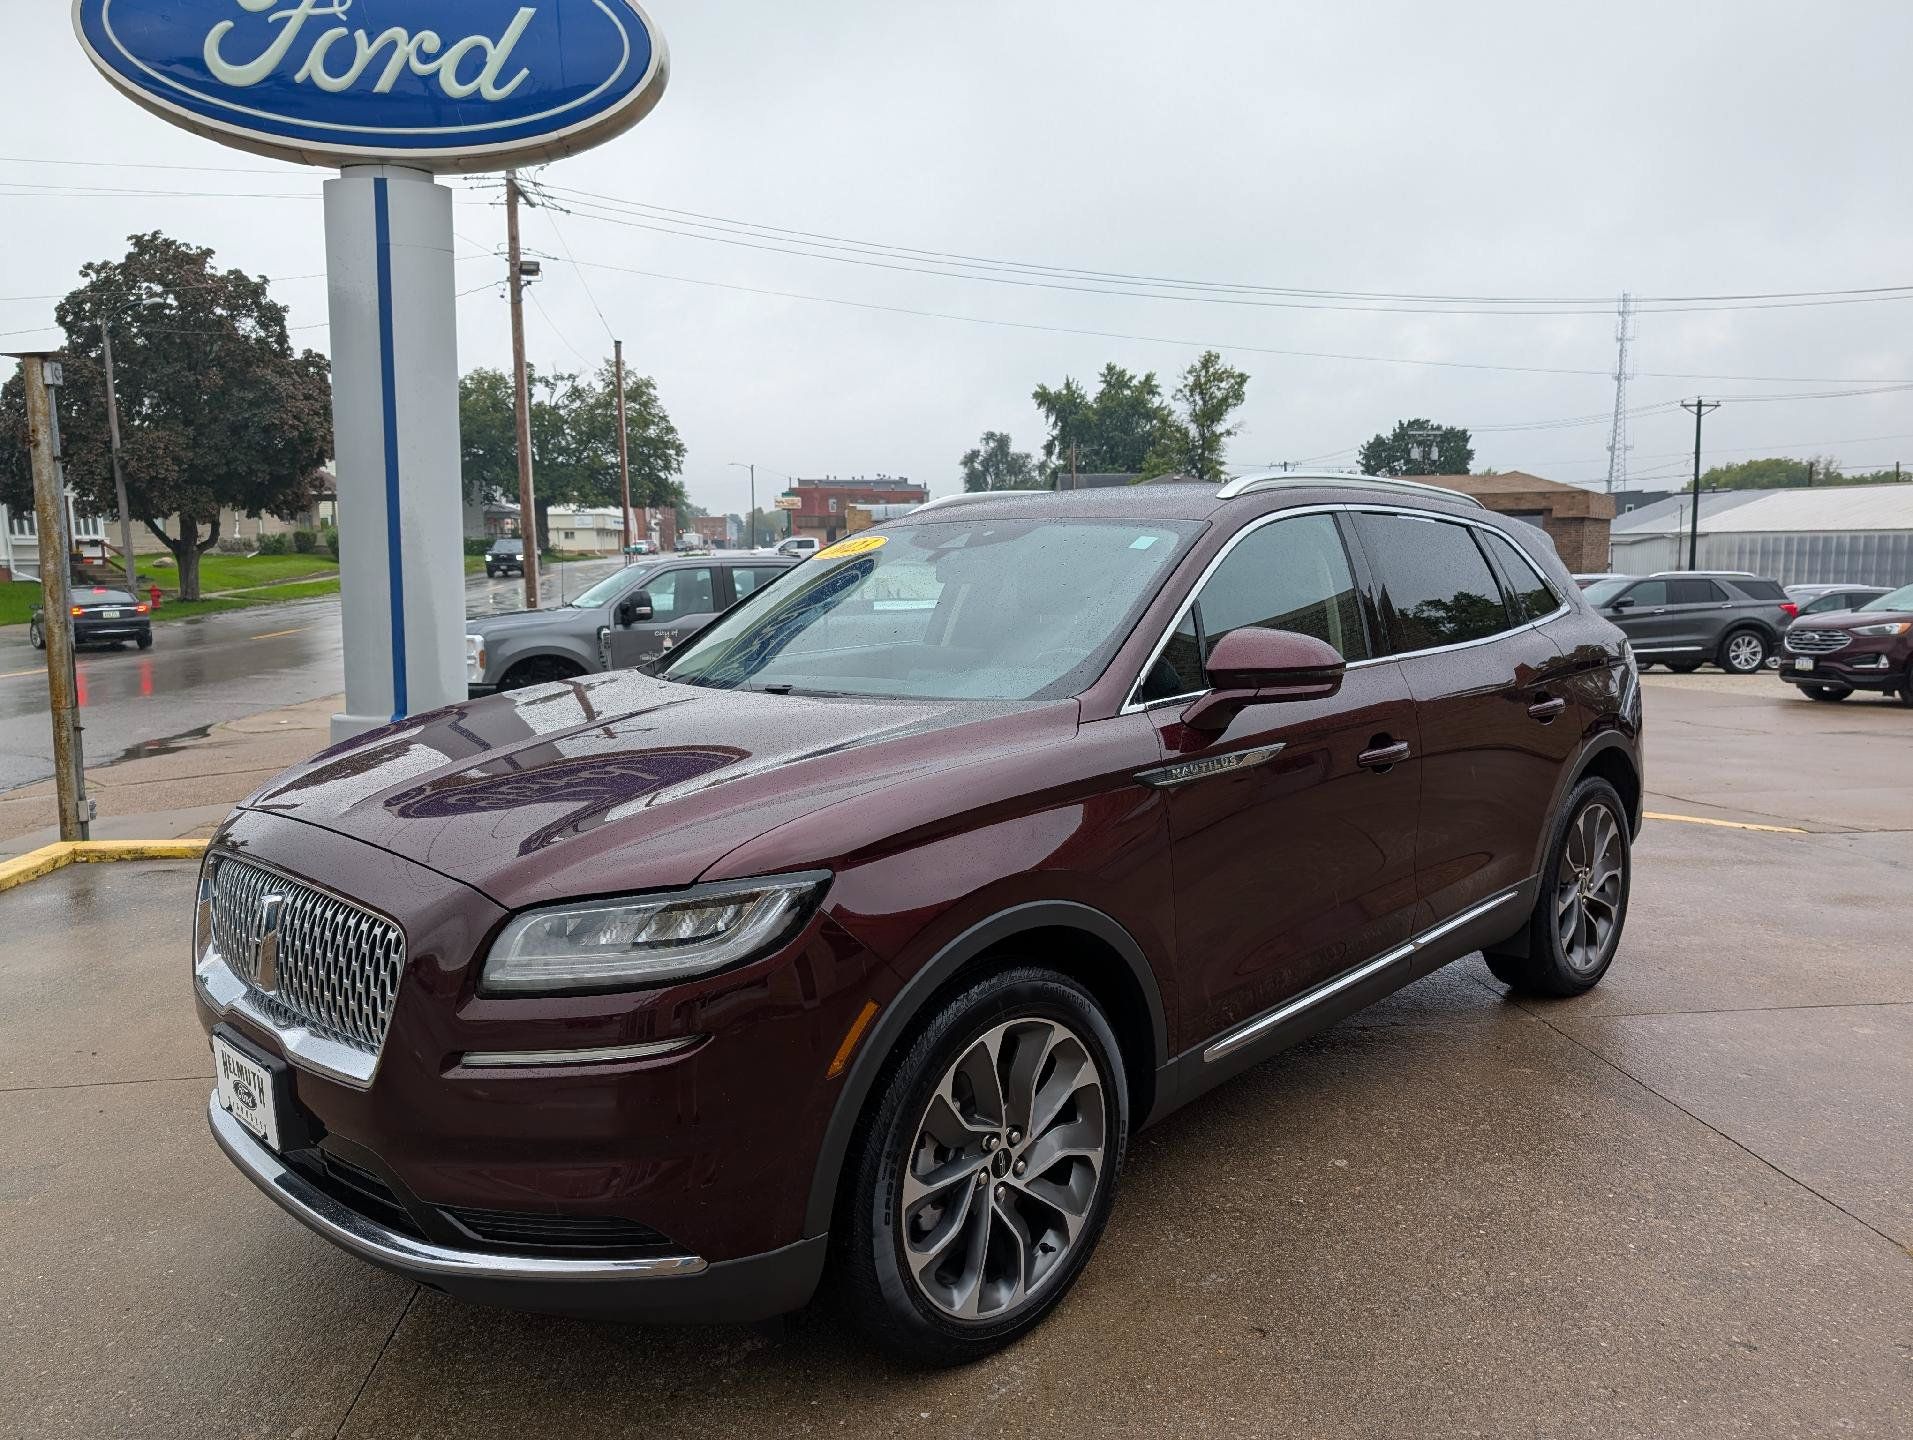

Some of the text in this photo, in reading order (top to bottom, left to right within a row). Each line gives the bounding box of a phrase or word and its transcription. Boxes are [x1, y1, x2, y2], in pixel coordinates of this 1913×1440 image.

[203, 0, 537, 101] Ford
[1171, 755, 1238, 779] NAUTILUS
[221, 1049, 266, 1109] HELMUTH
